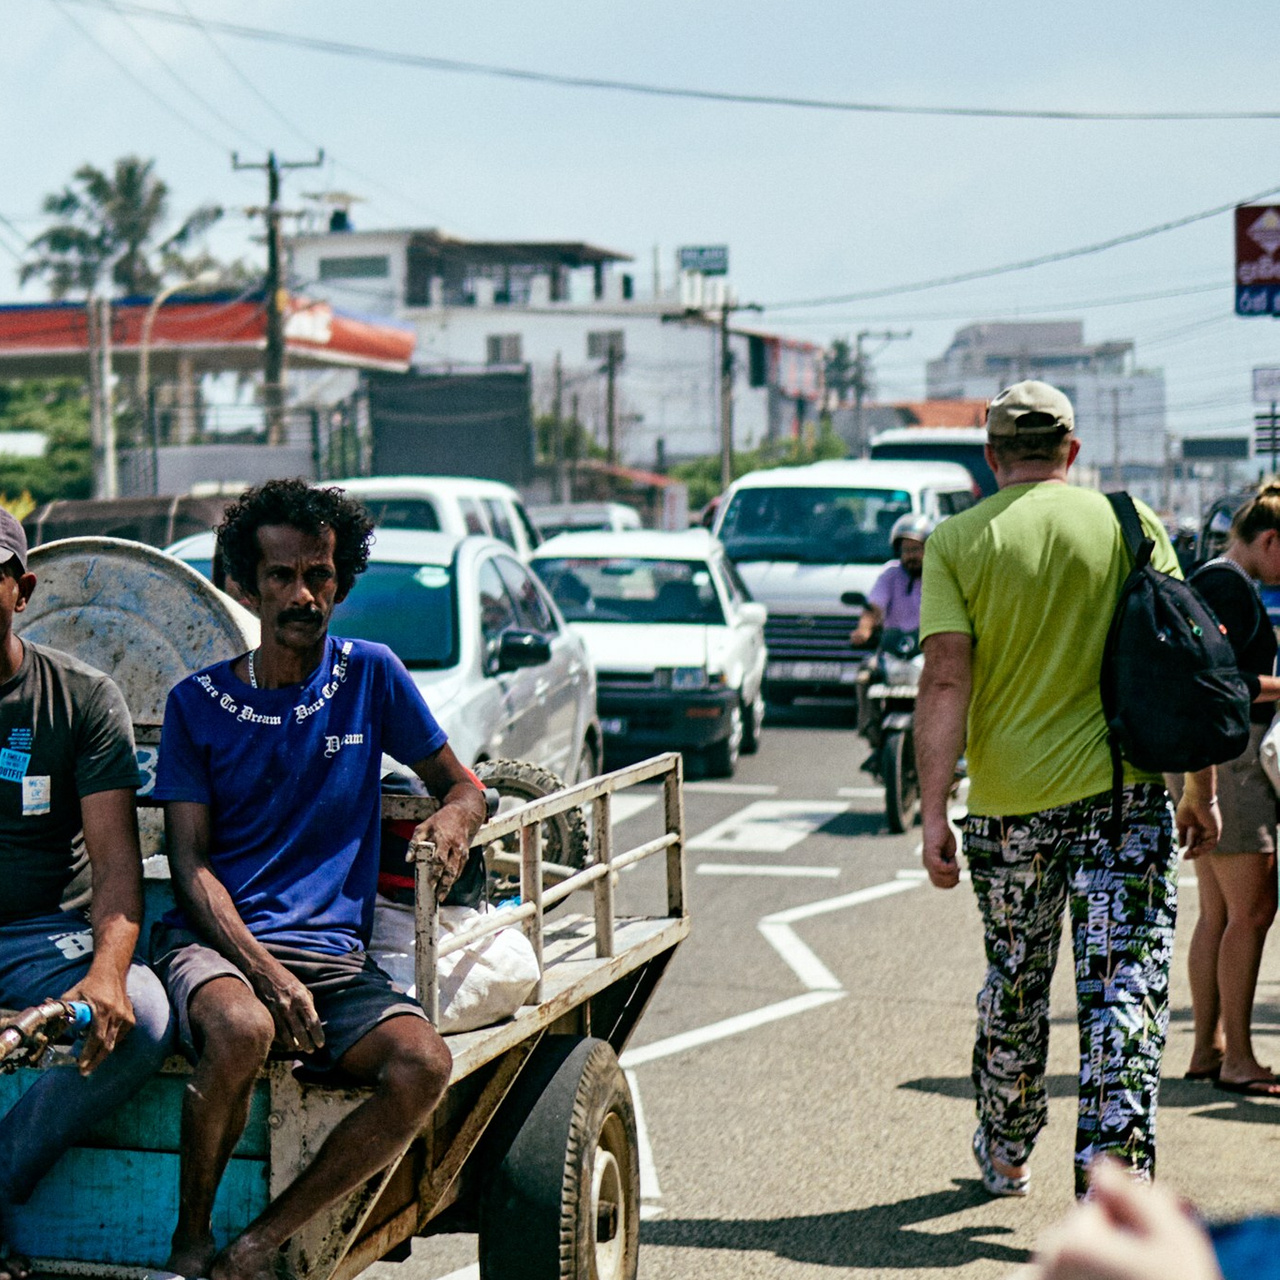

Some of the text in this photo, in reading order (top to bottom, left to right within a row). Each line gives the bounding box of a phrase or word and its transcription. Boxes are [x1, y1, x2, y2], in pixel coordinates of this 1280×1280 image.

[193, 674, 282, 725] Dare To Dream
[293, 698, 325, 725] Dare
[322, 682, 339, 699] To
[1086, 892, 1111, 957] RACING
